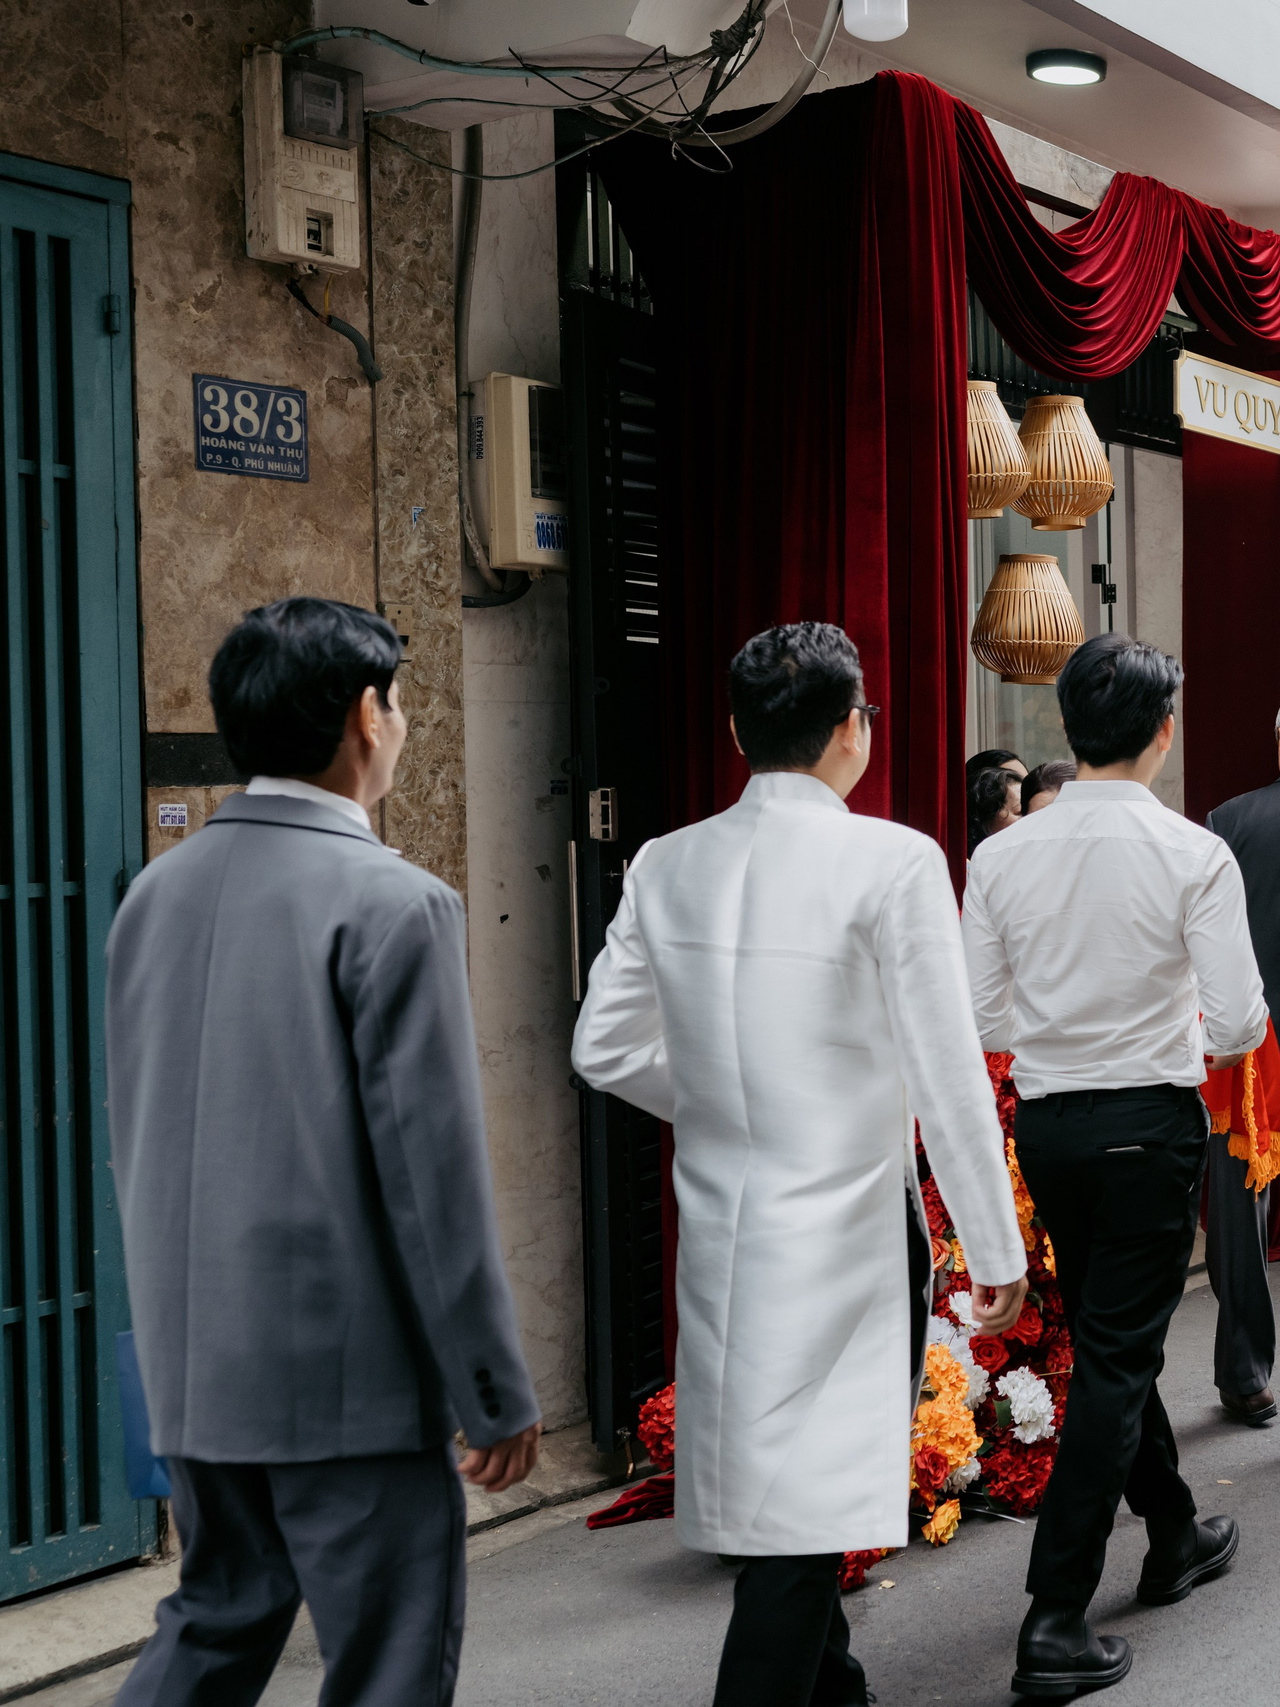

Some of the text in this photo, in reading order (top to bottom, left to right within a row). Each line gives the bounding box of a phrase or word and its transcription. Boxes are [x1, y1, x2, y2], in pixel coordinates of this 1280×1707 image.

[1194, 375, 1228, 418] VU
[203, 385, 302, 443] 38/3
[201, 436, 245, 451] HOÀNG
[278, 446, 303, 460] THỤ
[206, 453, 222, 464] P.9
[231, 456, 242, 468] Q.
[244, 458, 264, 470] PHÚ
[267, 462, 300, 474] NHUẬN
